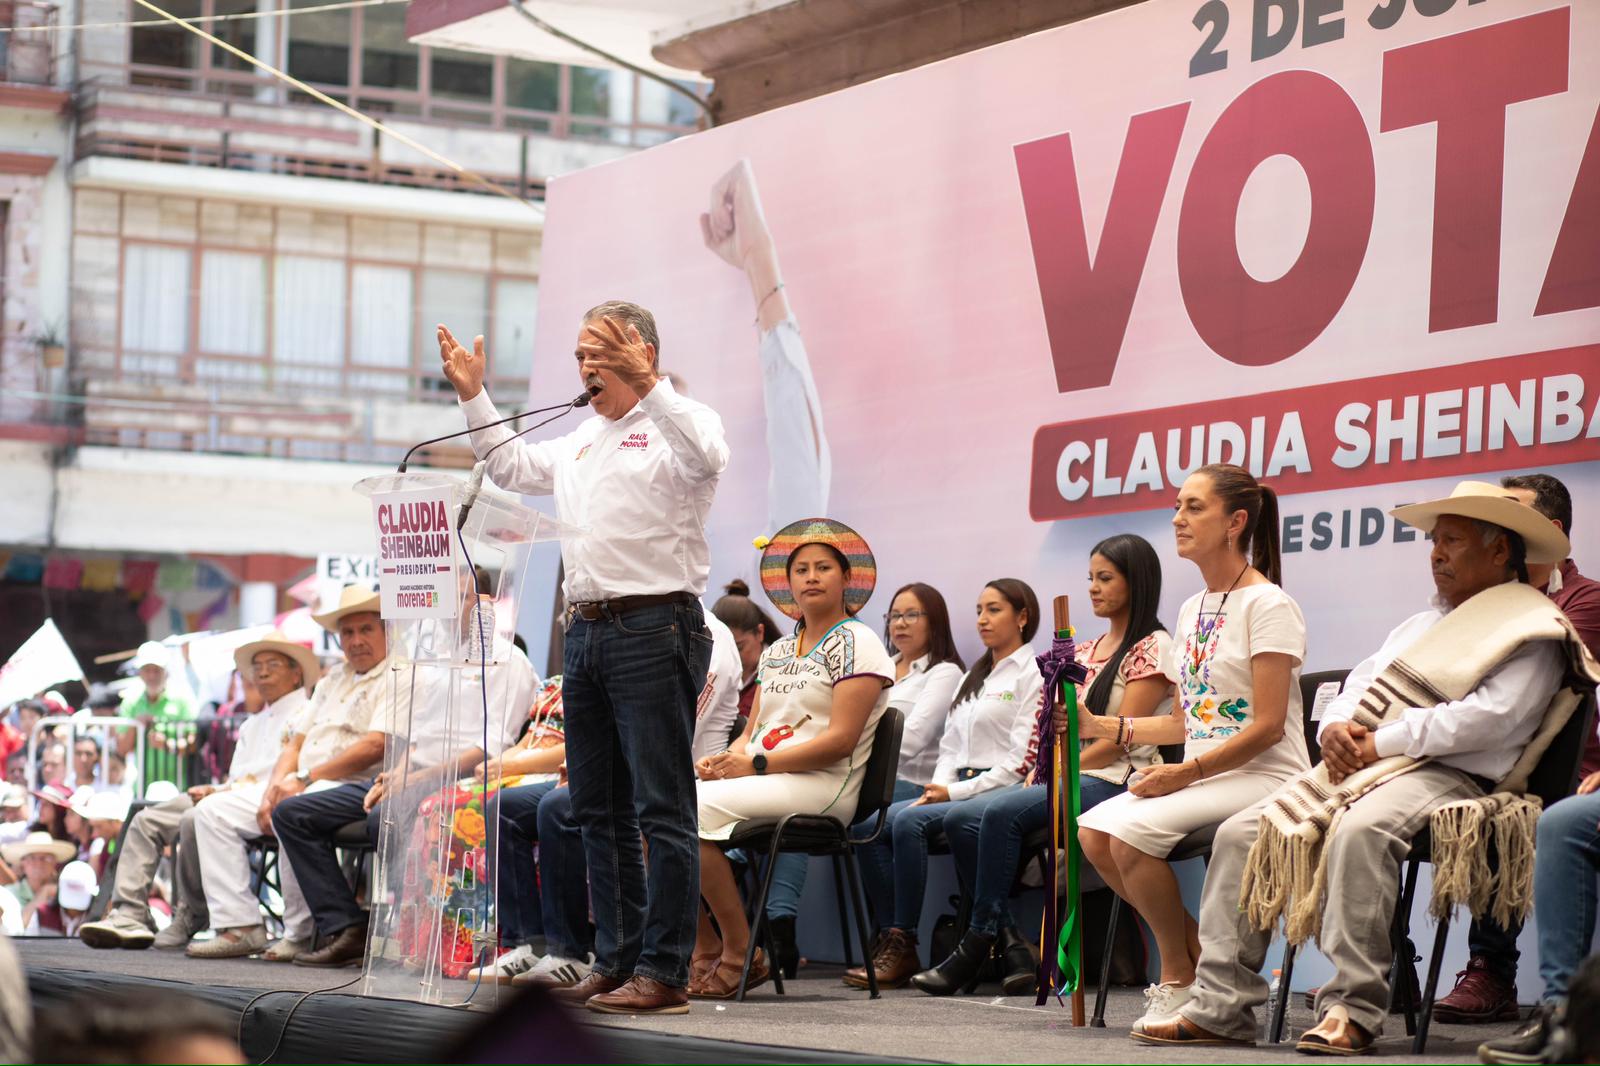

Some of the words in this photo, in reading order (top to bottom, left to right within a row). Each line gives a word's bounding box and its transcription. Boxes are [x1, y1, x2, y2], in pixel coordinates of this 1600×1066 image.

[1188, 0, 1229, 78] 2
[1250, 0, 1345, 62] DE
[1056, 410, 1312, 501] CLAUDIA
[1331, 373, 1600, 469] SHEINB
[377, 500, 449, 535] CLAUDIA
[1281, 503, 1433, 554] ESIDE
[380, 533, 450, 560] SHEINBAUM
[396, 563, 437, 575] PRESIDENTA
[396, 592, 426, 608] morena
